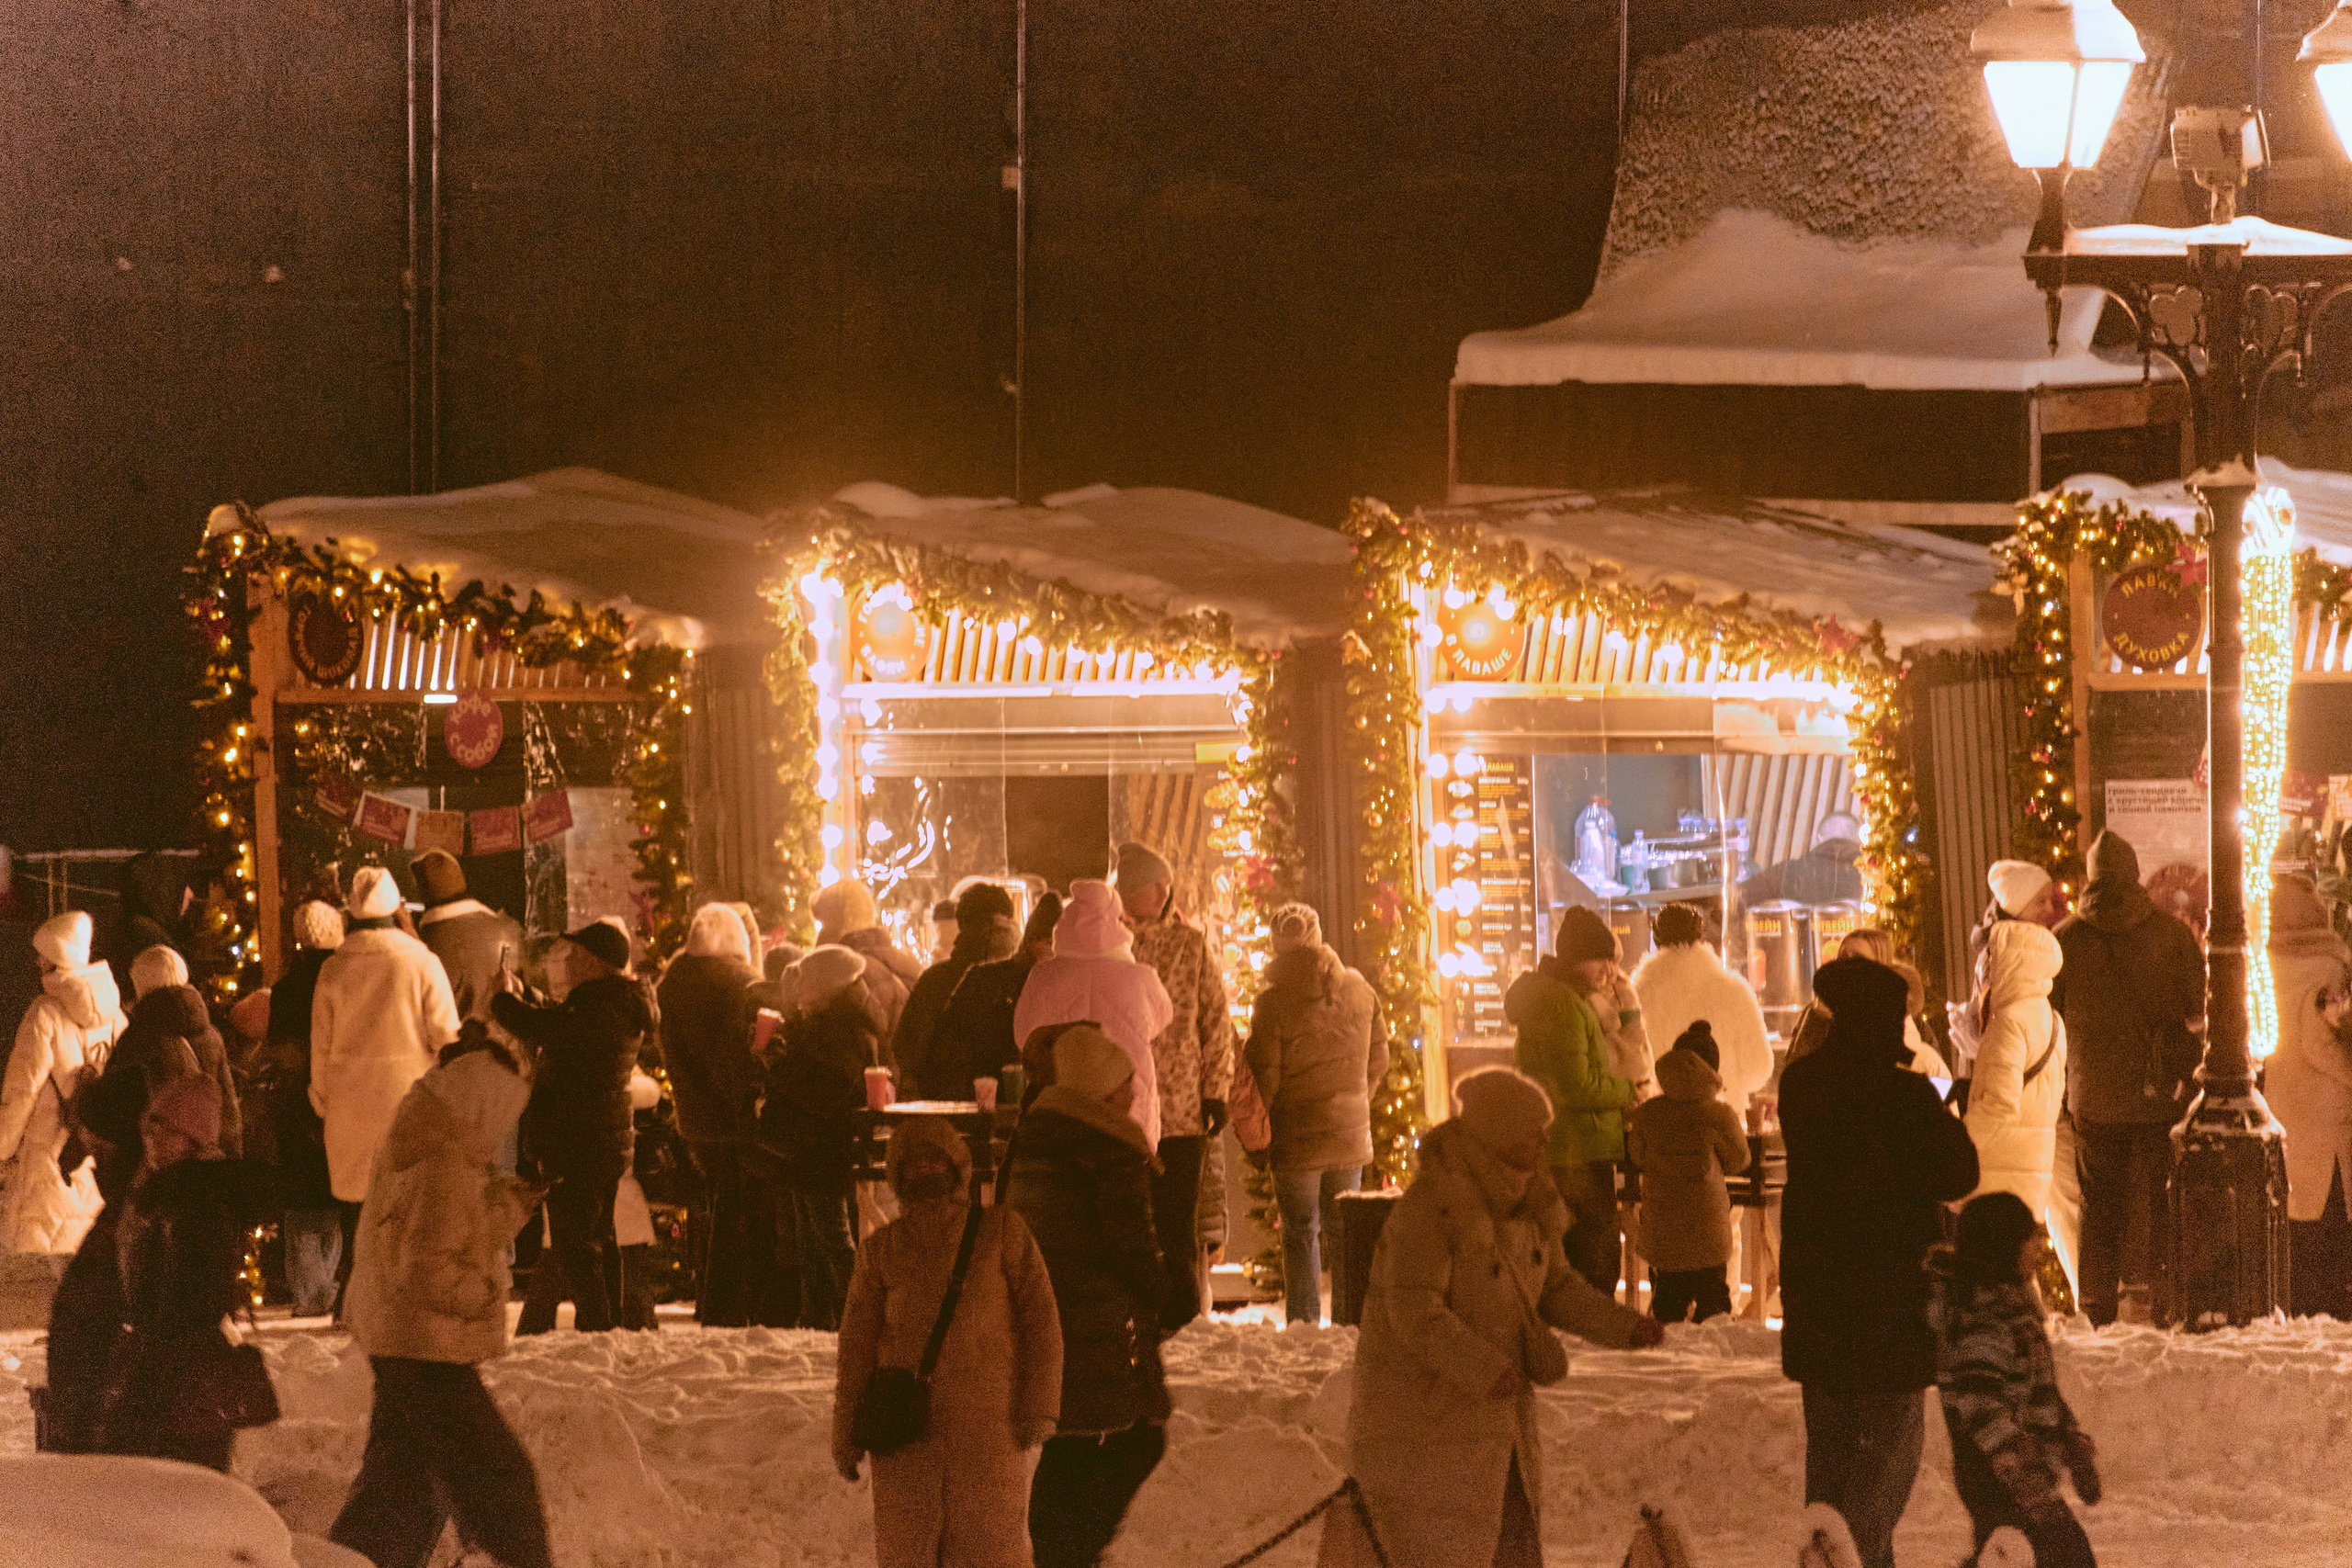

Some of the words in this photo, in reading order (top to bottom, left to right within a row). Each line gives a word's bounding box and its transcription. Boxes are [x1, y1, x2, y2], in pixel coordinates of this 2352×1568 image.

[861, 643, 906, 675] ВАФЛИ
[1445, 633, 1457, 647] В
[1452, 646, 1513, 675] ЛАВАШЕ
[2114, 632, 2189, 662] ДУХОВКА
[457, 723, 499, 763] собой
